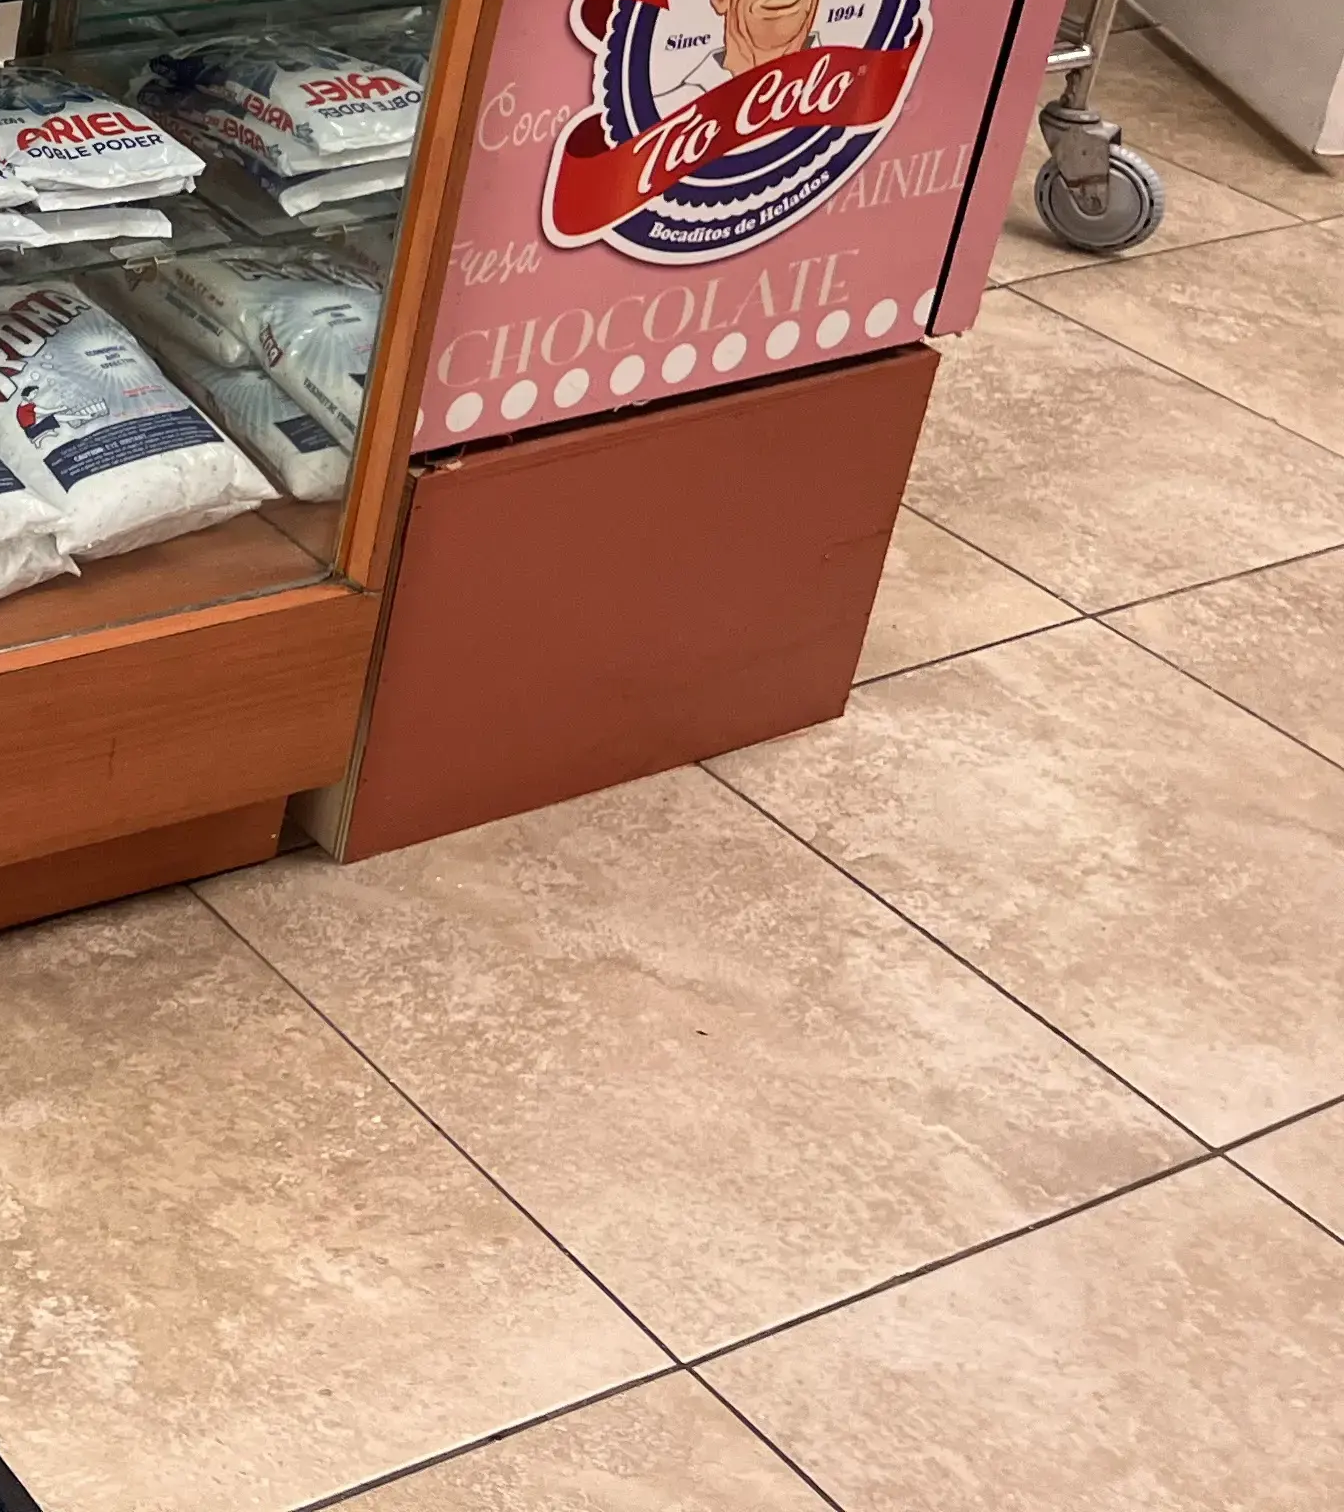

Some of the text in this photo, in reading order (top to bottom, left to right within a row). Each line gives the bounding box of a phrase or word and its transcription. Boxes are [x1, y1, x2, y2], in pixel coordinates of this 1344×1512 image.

[826, 3, 866, 24] 1994
[665, 32, 711, 51] Since
[478, 82, 570, 151] Coco
[735, 52, 854, 136] Colo
[16, 112, 153, 152] ARIEL
[28, 134, 165, 161] DOBLE PODER
[648, 169, 832, 244] Bocaditos de Helados
[437, 248, 859, 390] CHOCOLATE
